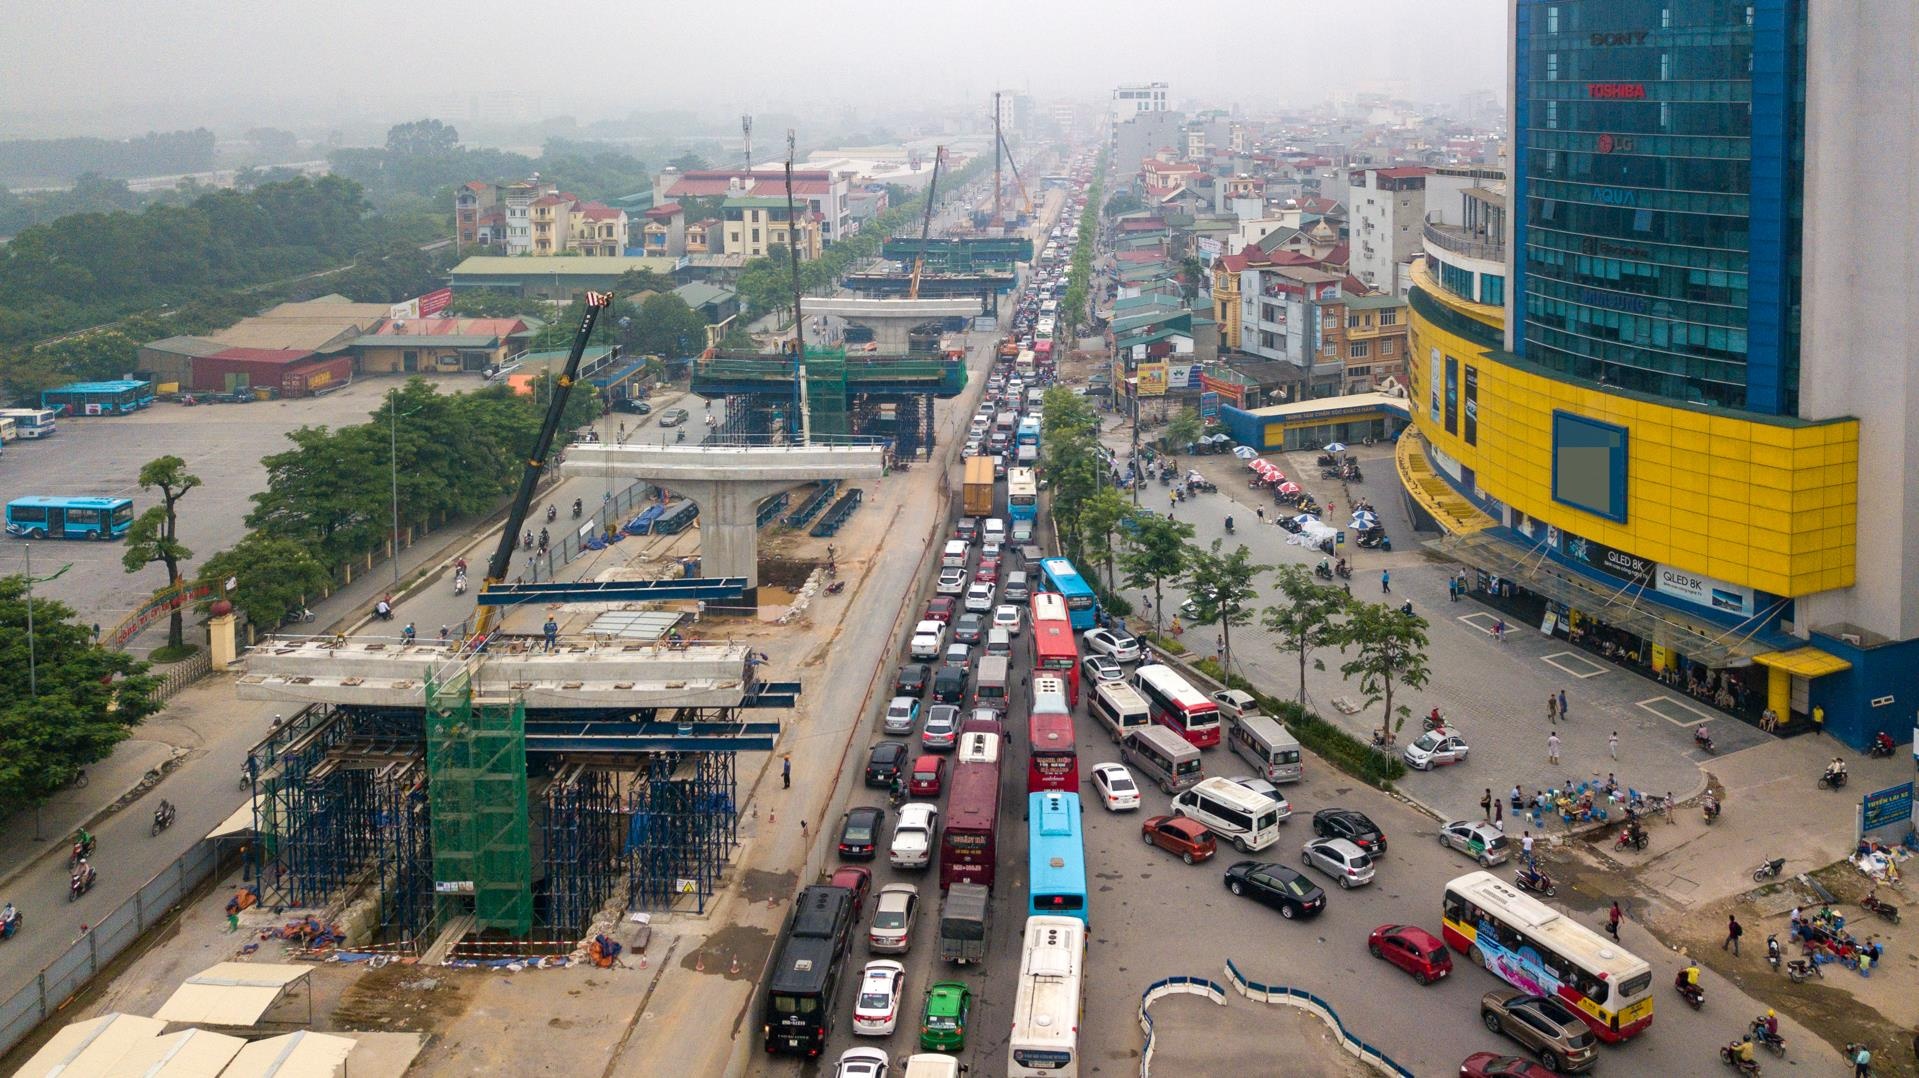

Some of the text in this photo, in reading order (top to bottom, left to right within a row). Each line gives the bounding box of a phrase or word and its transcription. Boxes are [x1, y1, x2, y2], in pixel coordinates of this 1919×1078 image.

[1590, 31, 1649, 46] SONY
[1586, 83, 1647, 98] TOSHIBA
[1615, 136, 1633, 150] LG
[1592, 187, 1636, 205] AQUA
[1608, 551, 1644, 572] QLED 8K
[1663, 571, 1703, 591] QLED 8K
